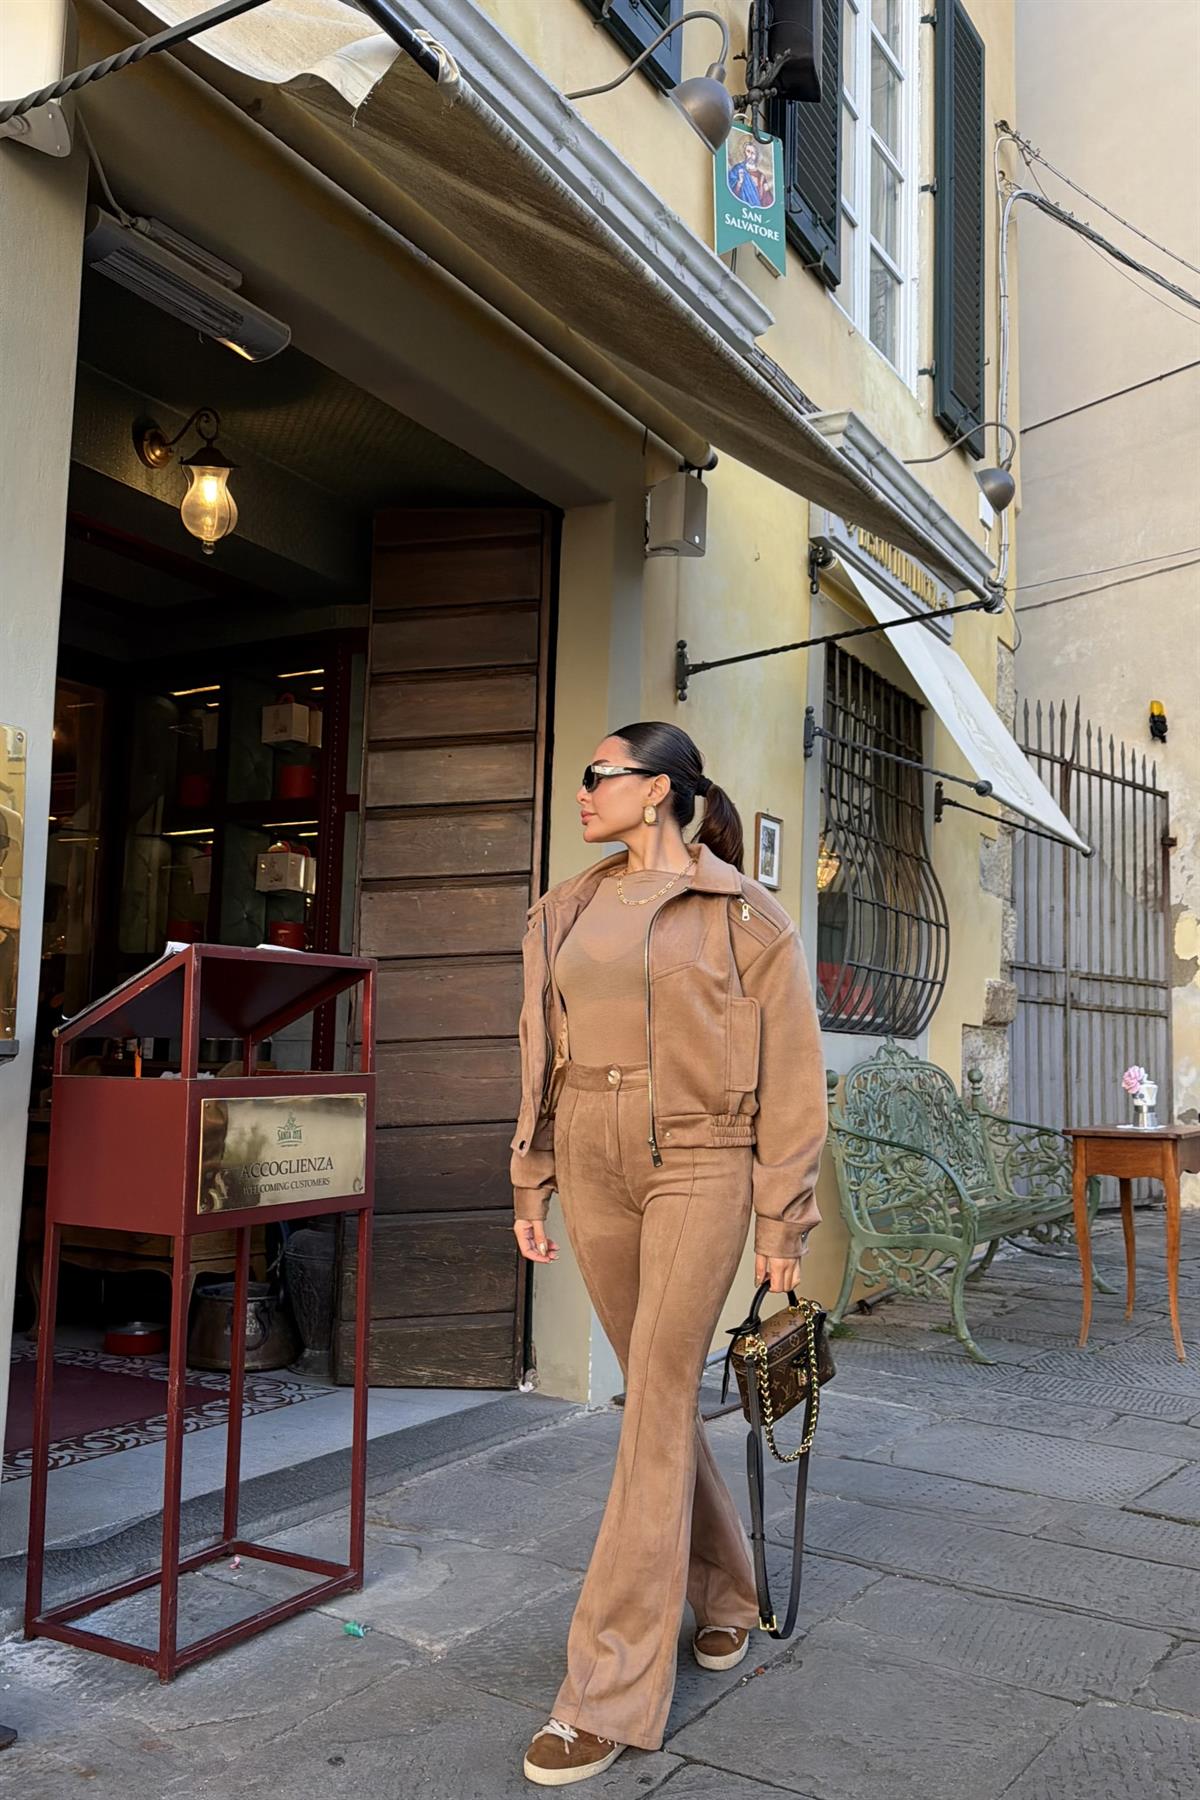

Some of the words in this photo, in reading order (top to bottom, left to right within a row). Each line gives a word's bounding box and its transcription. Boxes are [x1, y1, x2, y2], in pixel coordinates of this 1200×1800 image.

[742, 207, 762, 223] SAN
[725, 213, 780, 241] SALVATORE
[241, 1156, 334, 1178] ACCOGLIENZA
[243, 1181, 289, 1195] WELCOMING
[290, 1177, 330, 1190] CUSTOMERS
